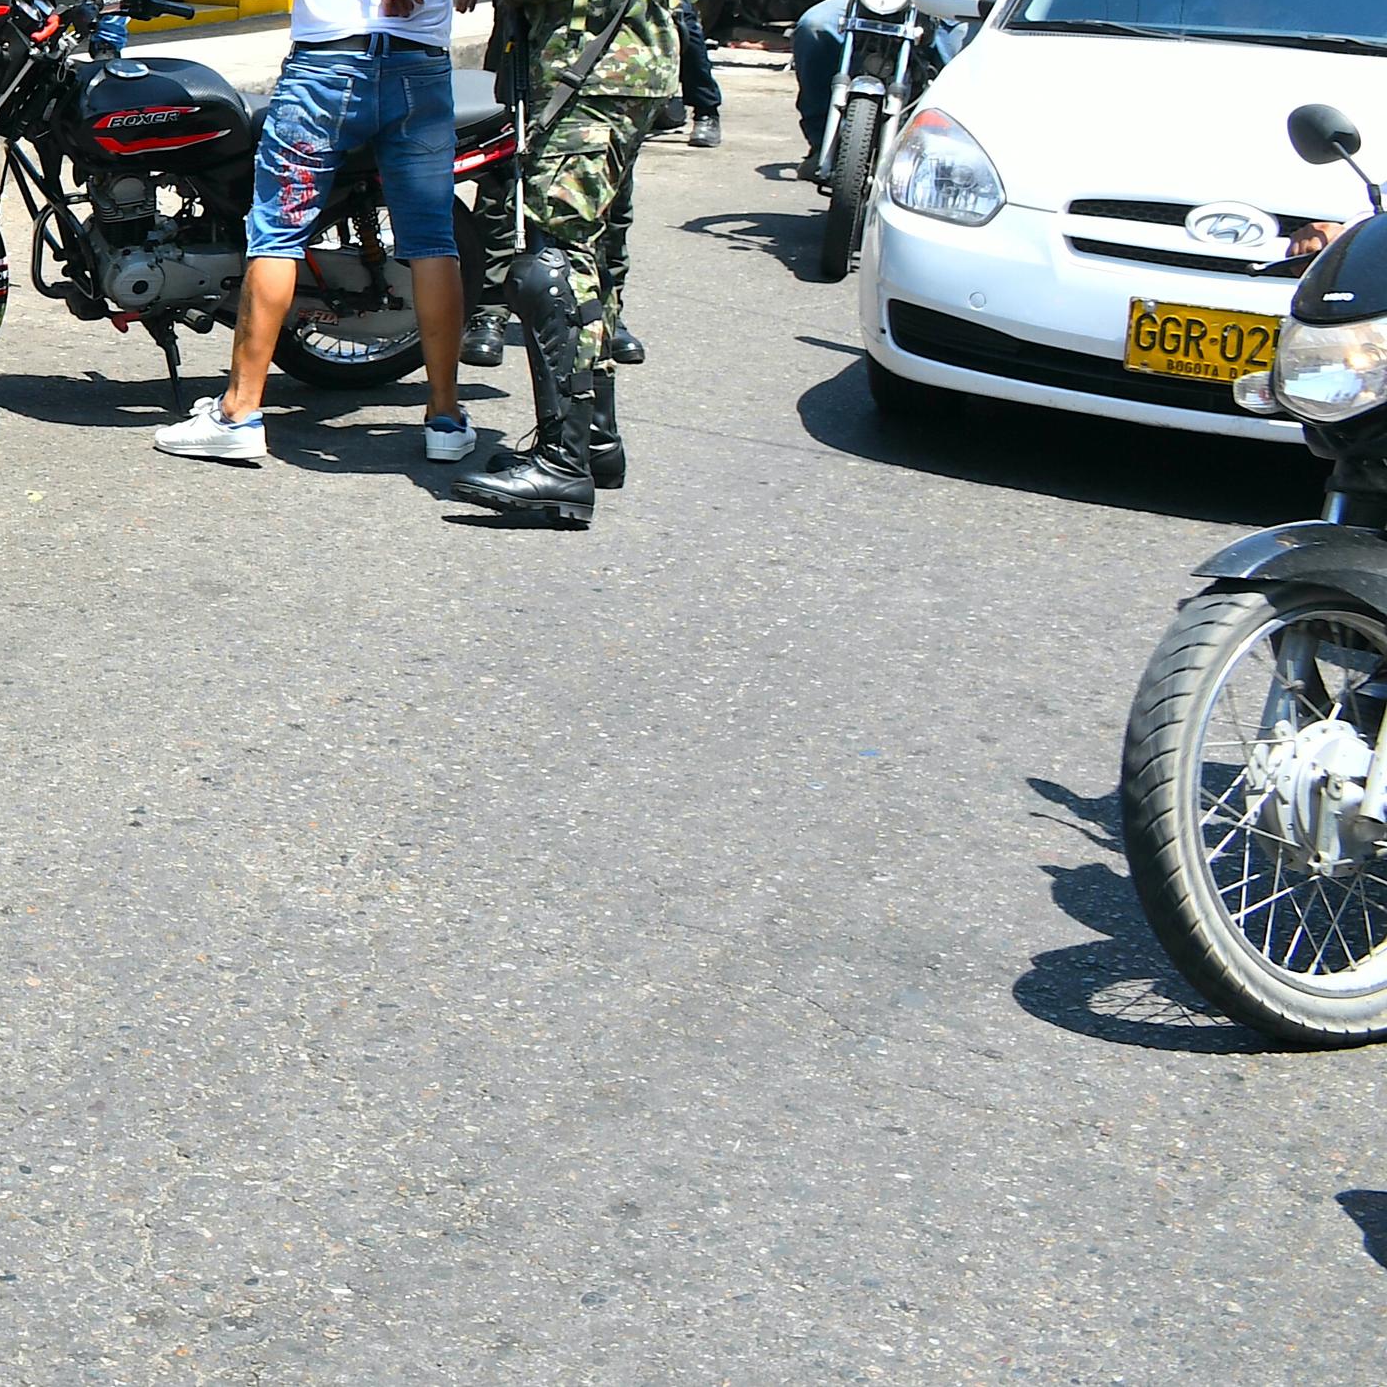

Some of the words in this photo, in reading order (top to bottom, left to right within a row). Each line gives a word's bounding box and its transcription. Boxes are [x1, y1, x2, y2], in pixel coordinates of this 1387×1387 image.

[107, 111, 180, 128] BOXER
[1135, 314, 1280, 367] GGR-02
[1167, 359, 1219, 378] BOGOTA
